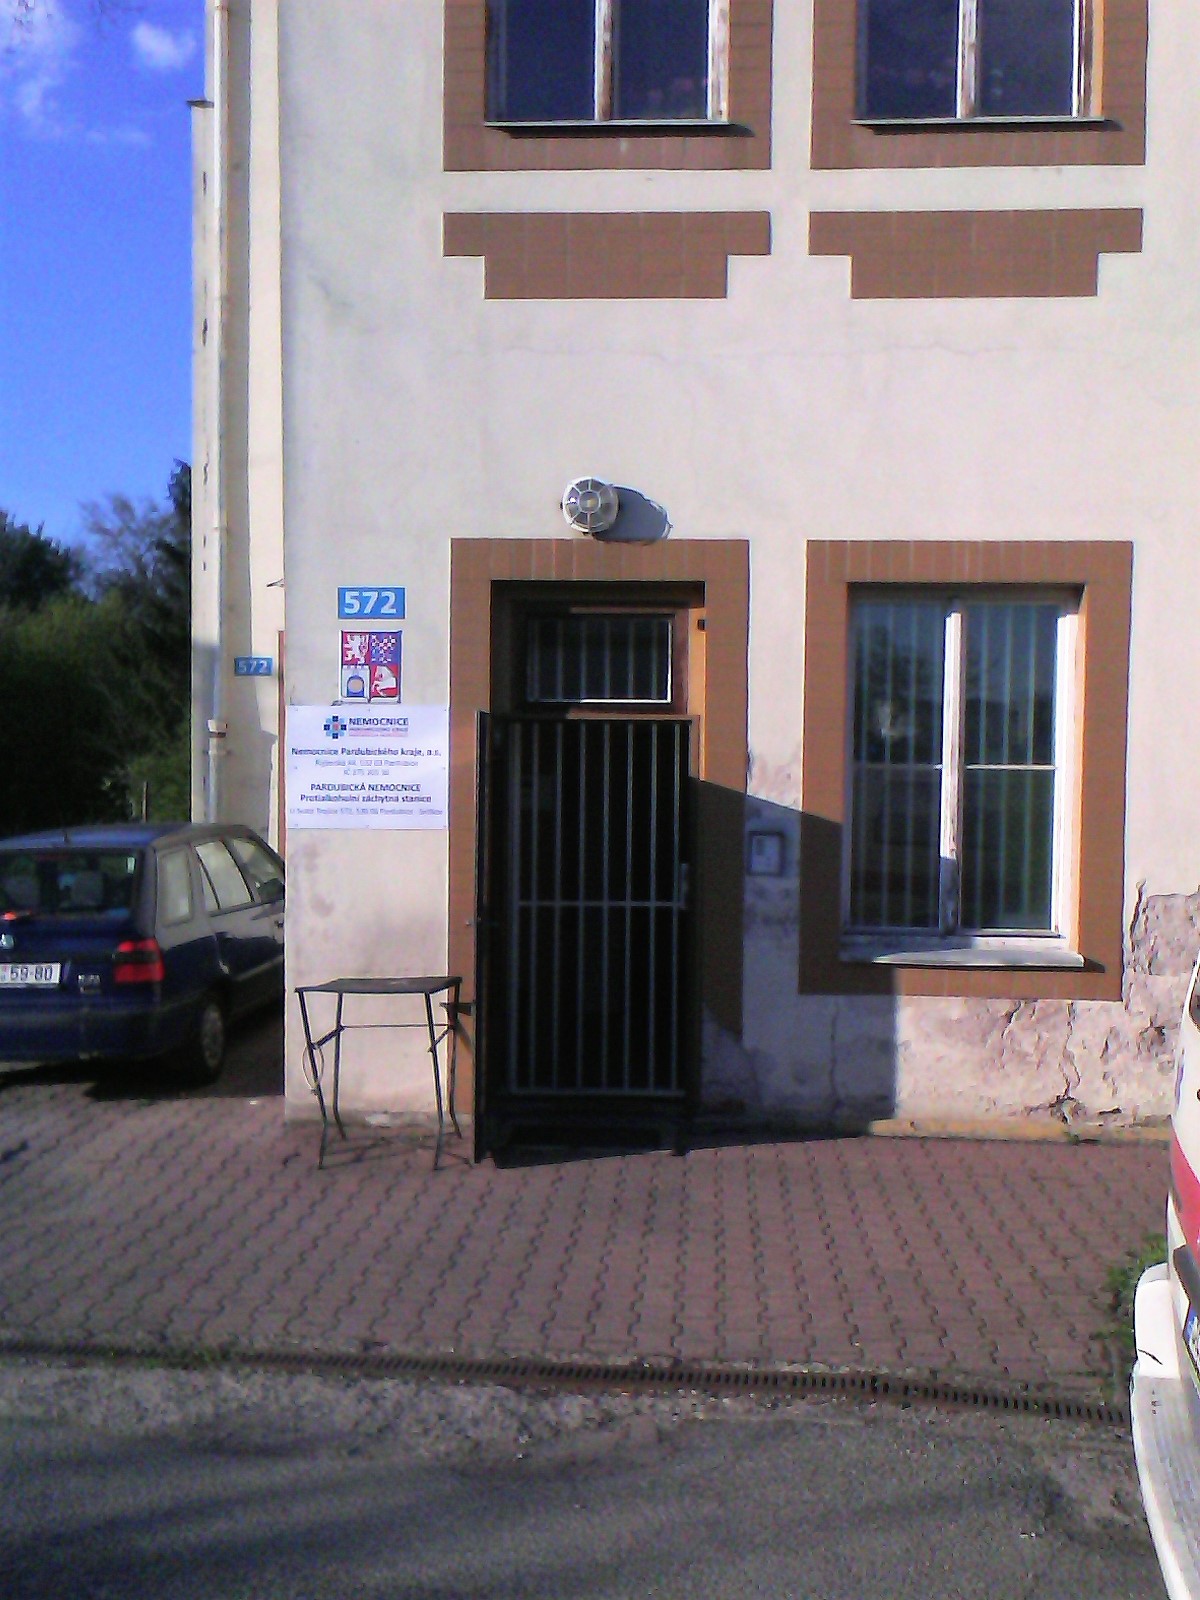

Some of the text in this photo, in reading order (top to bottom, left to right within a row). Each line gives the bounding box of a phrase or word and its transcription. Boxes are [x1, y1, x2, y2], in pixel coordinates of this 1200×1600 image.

[344, 591, 396, 614] 572
[239, 660, 268, 673] 572
[341, 747, 399, 755] Pardubického
[401, 748, 424, 757] kraje,
[311, 783, 366, 791] PARDUBICKÁ
[300, 794, 360, 802] Protialkoholní
[362, 795, 399, 803] záchytná
